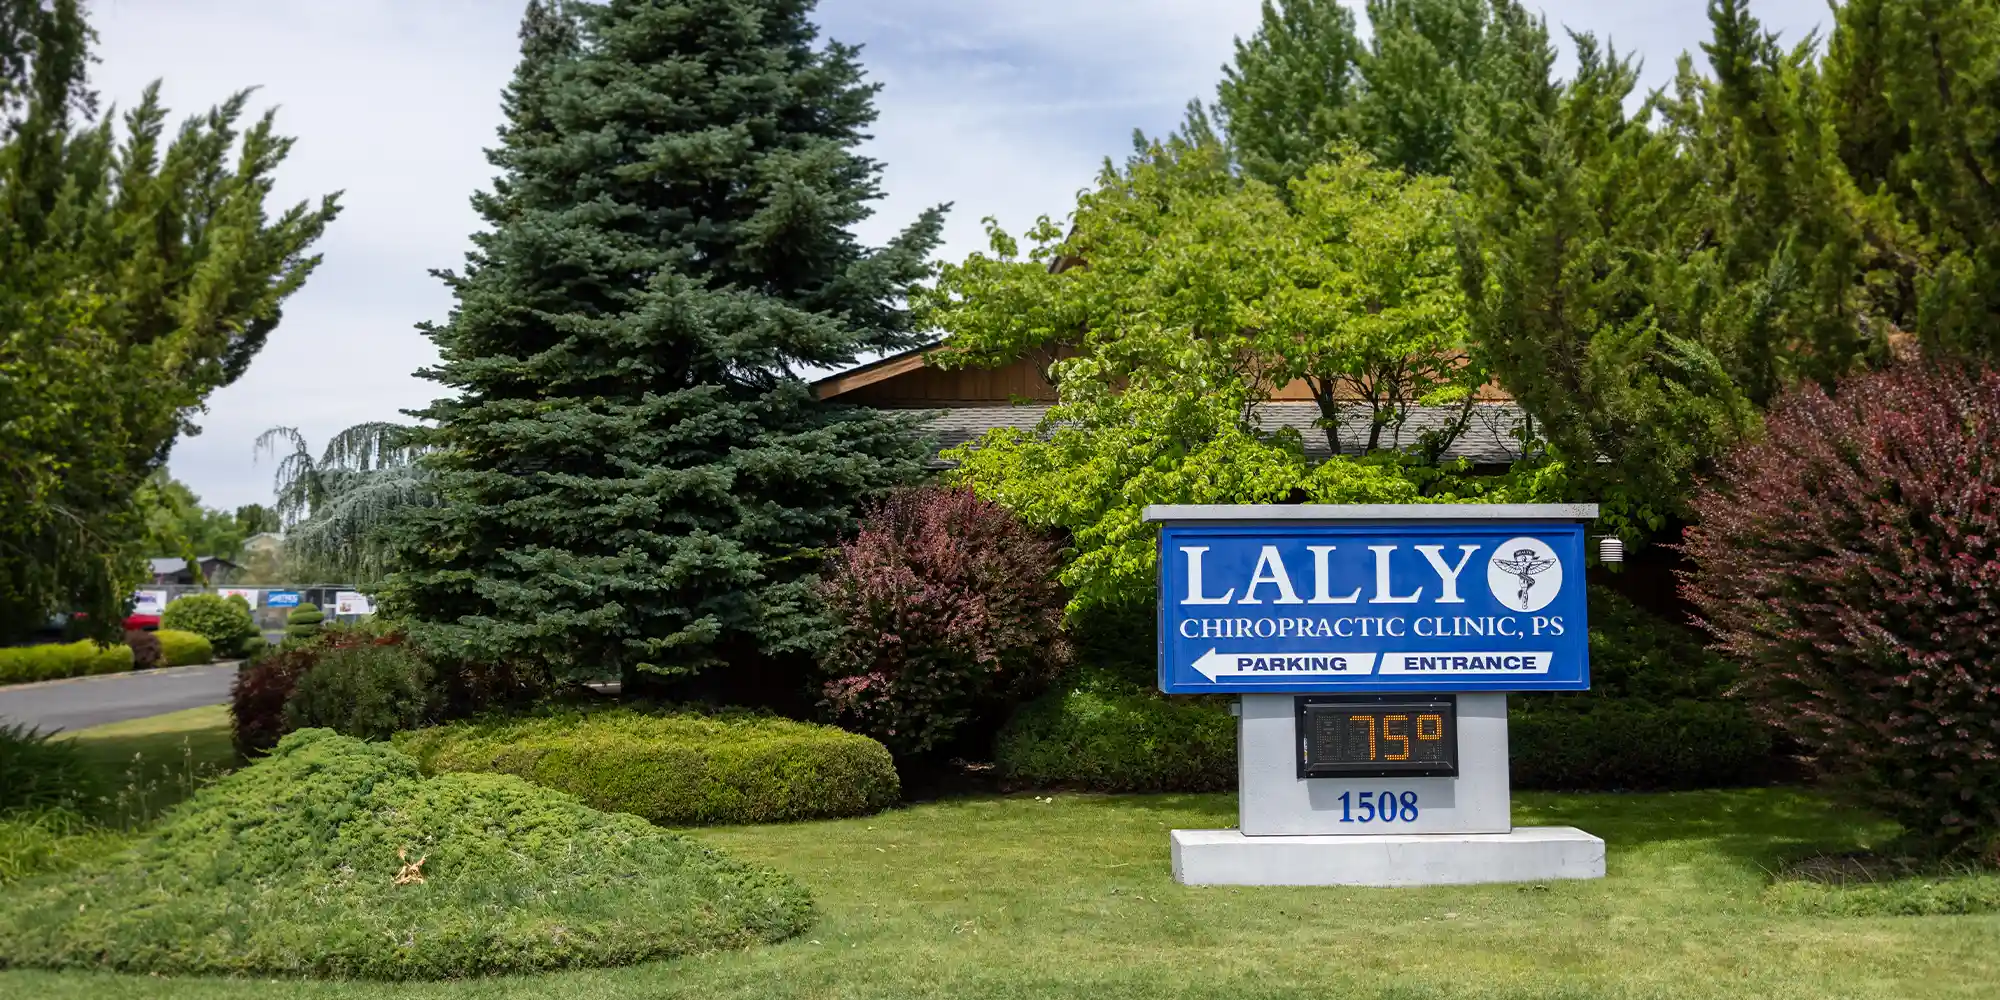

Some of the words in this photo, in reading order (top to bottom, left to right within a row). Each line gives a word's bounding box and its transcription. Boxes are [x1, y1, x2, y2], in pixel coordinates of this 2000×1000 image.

[1180, 544, 1481, 604] LALLY
[1179, 617, 1405, 638] CHIROPRACTIC
[1413, 617, 1524, 638] CLINIC,
[1532, 617, 1564, 636] PS
[1237, 657, 1347, 672] PARKING
[1404, 656, 1537, 671] ENTRANCE
[1337, 791, 1419, 823] 1508
